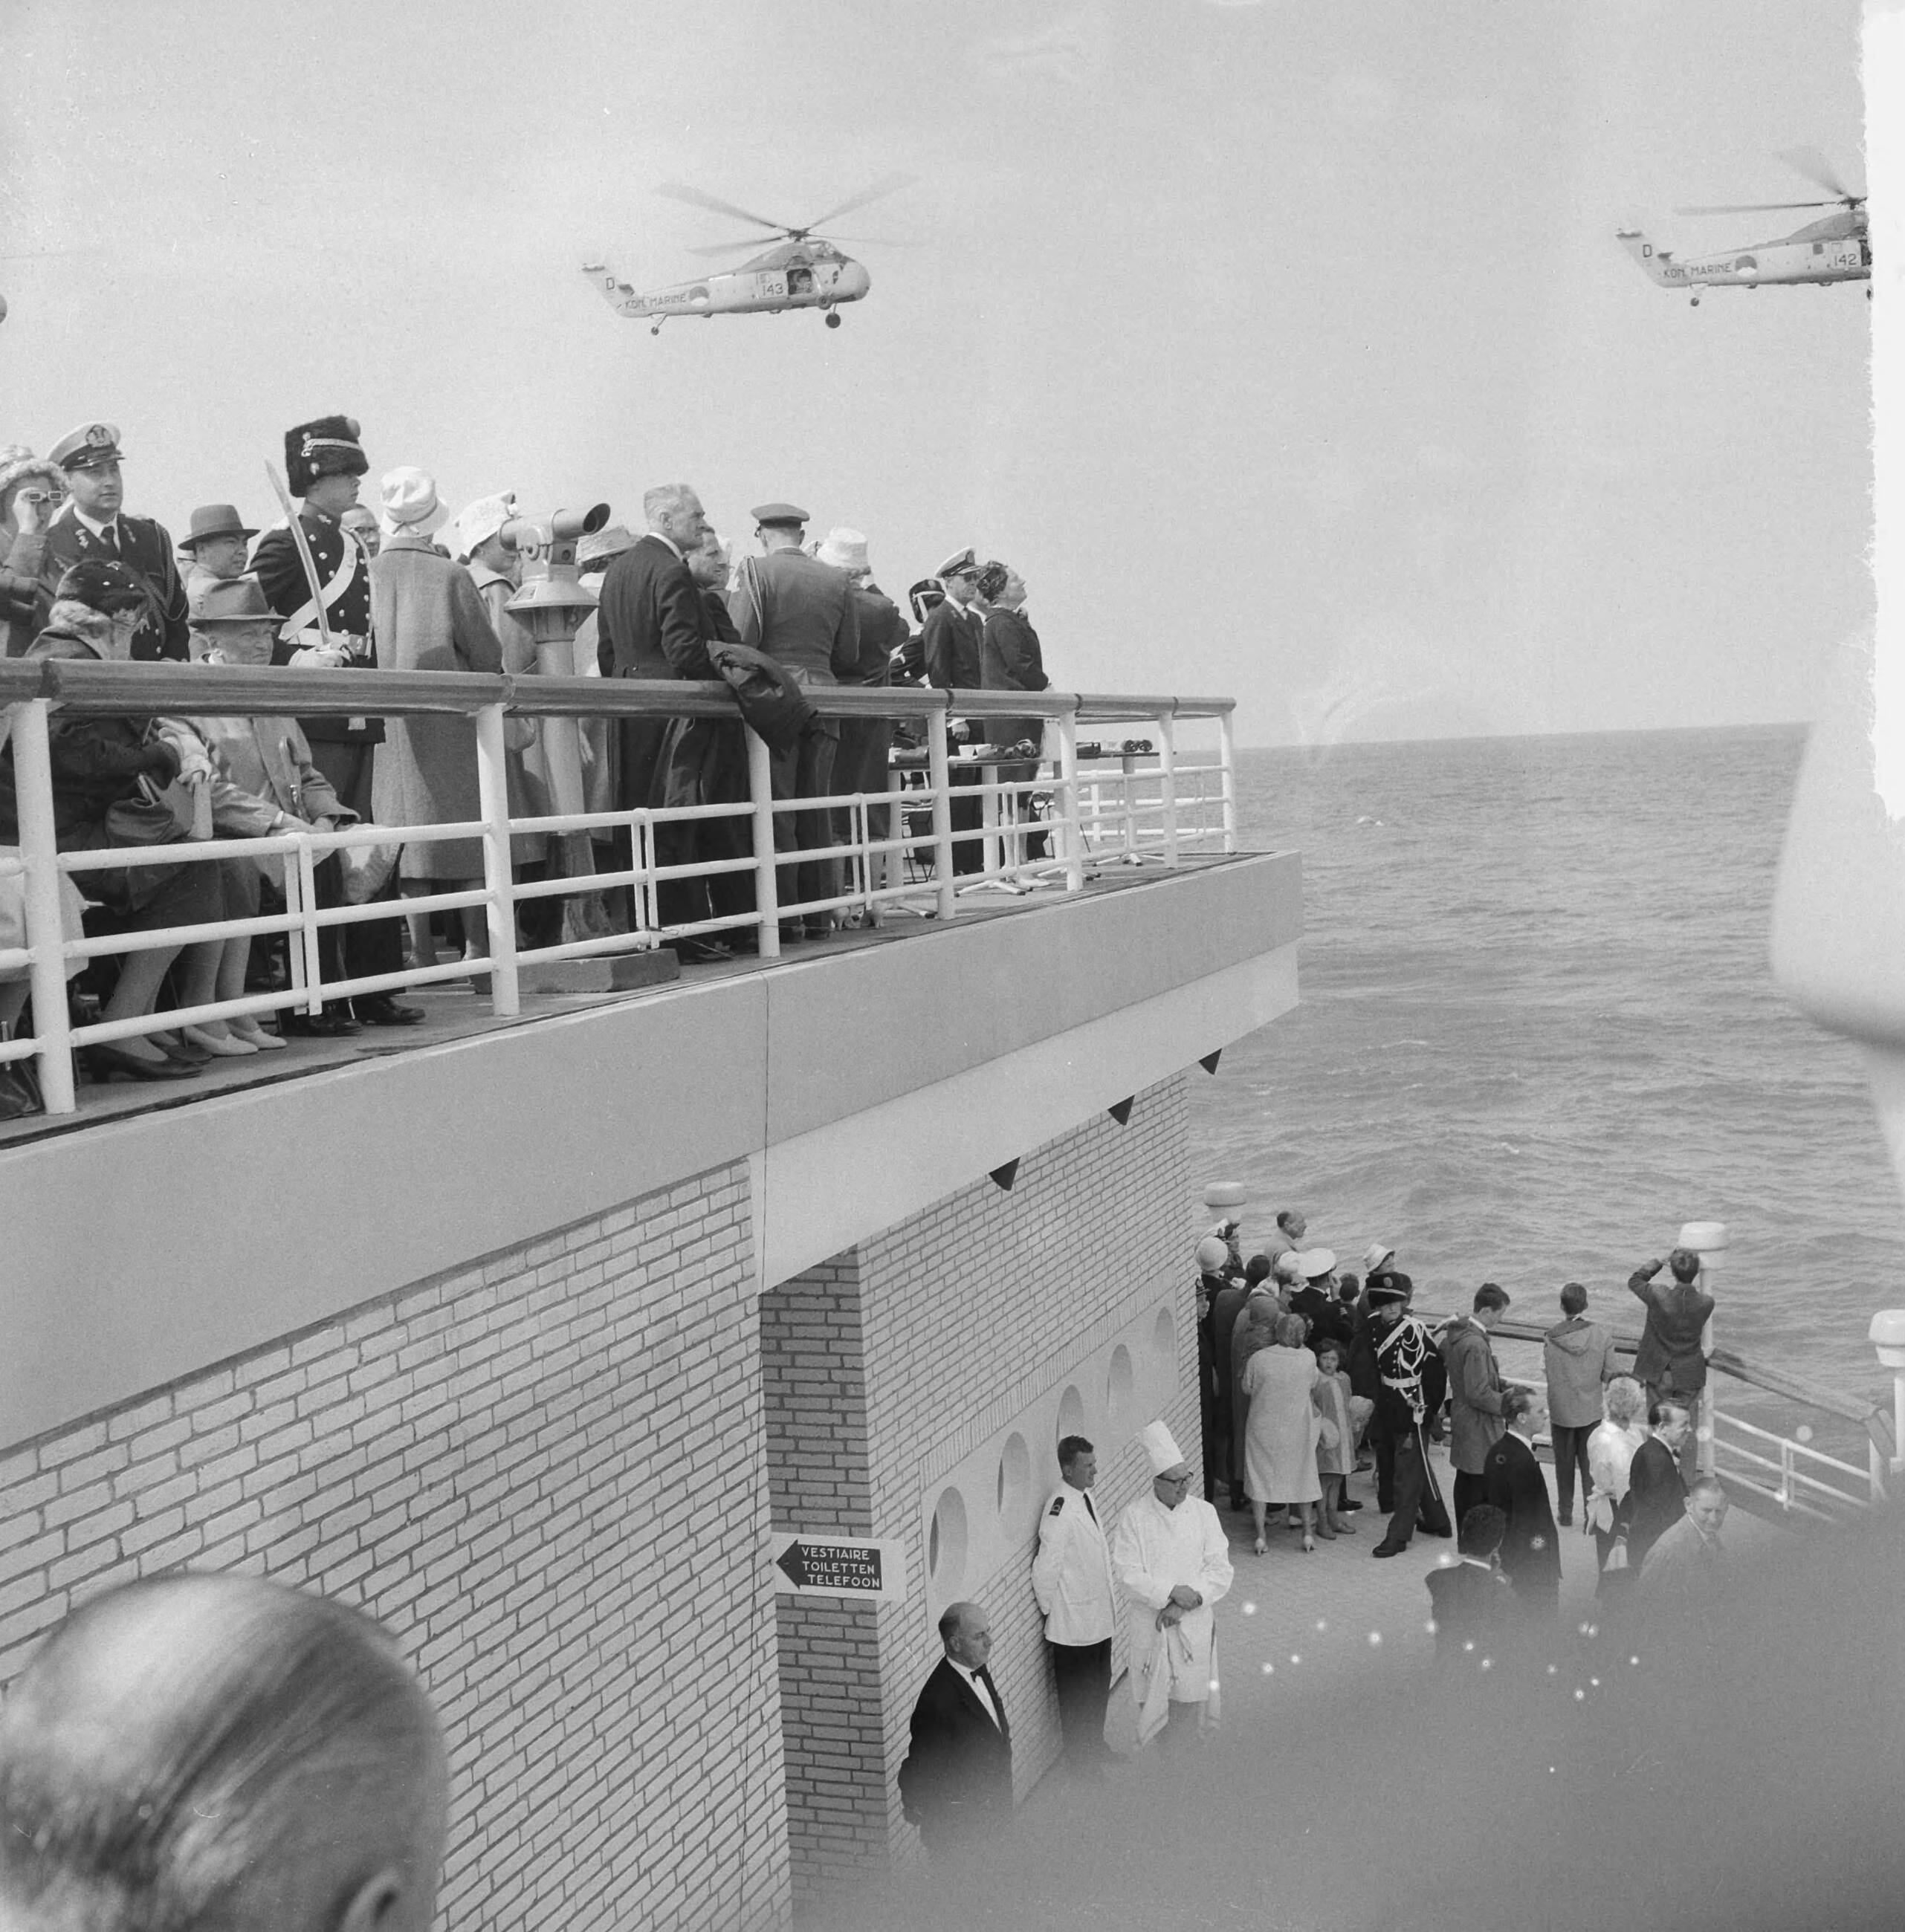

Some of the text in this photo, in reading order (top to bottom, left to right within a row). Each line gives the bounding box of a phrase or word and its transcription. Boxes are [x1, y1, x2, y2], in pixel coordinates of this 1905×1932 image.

[1643, 244, 1652, 258] D
[1834, 253, 1857, 266] 142
[1690, 262, 1732, 277] MARINE
[605, 276, 615, 291] D
[763, 282, 784, 296] 143
[650, 294, 687, 309] MARINE
[801, 1546, 870, 1560] VESTIAIRE
[802, 1560, 876, 1575] TOILETTEN
[807, 1574, 881, 1588] TELEFOON
